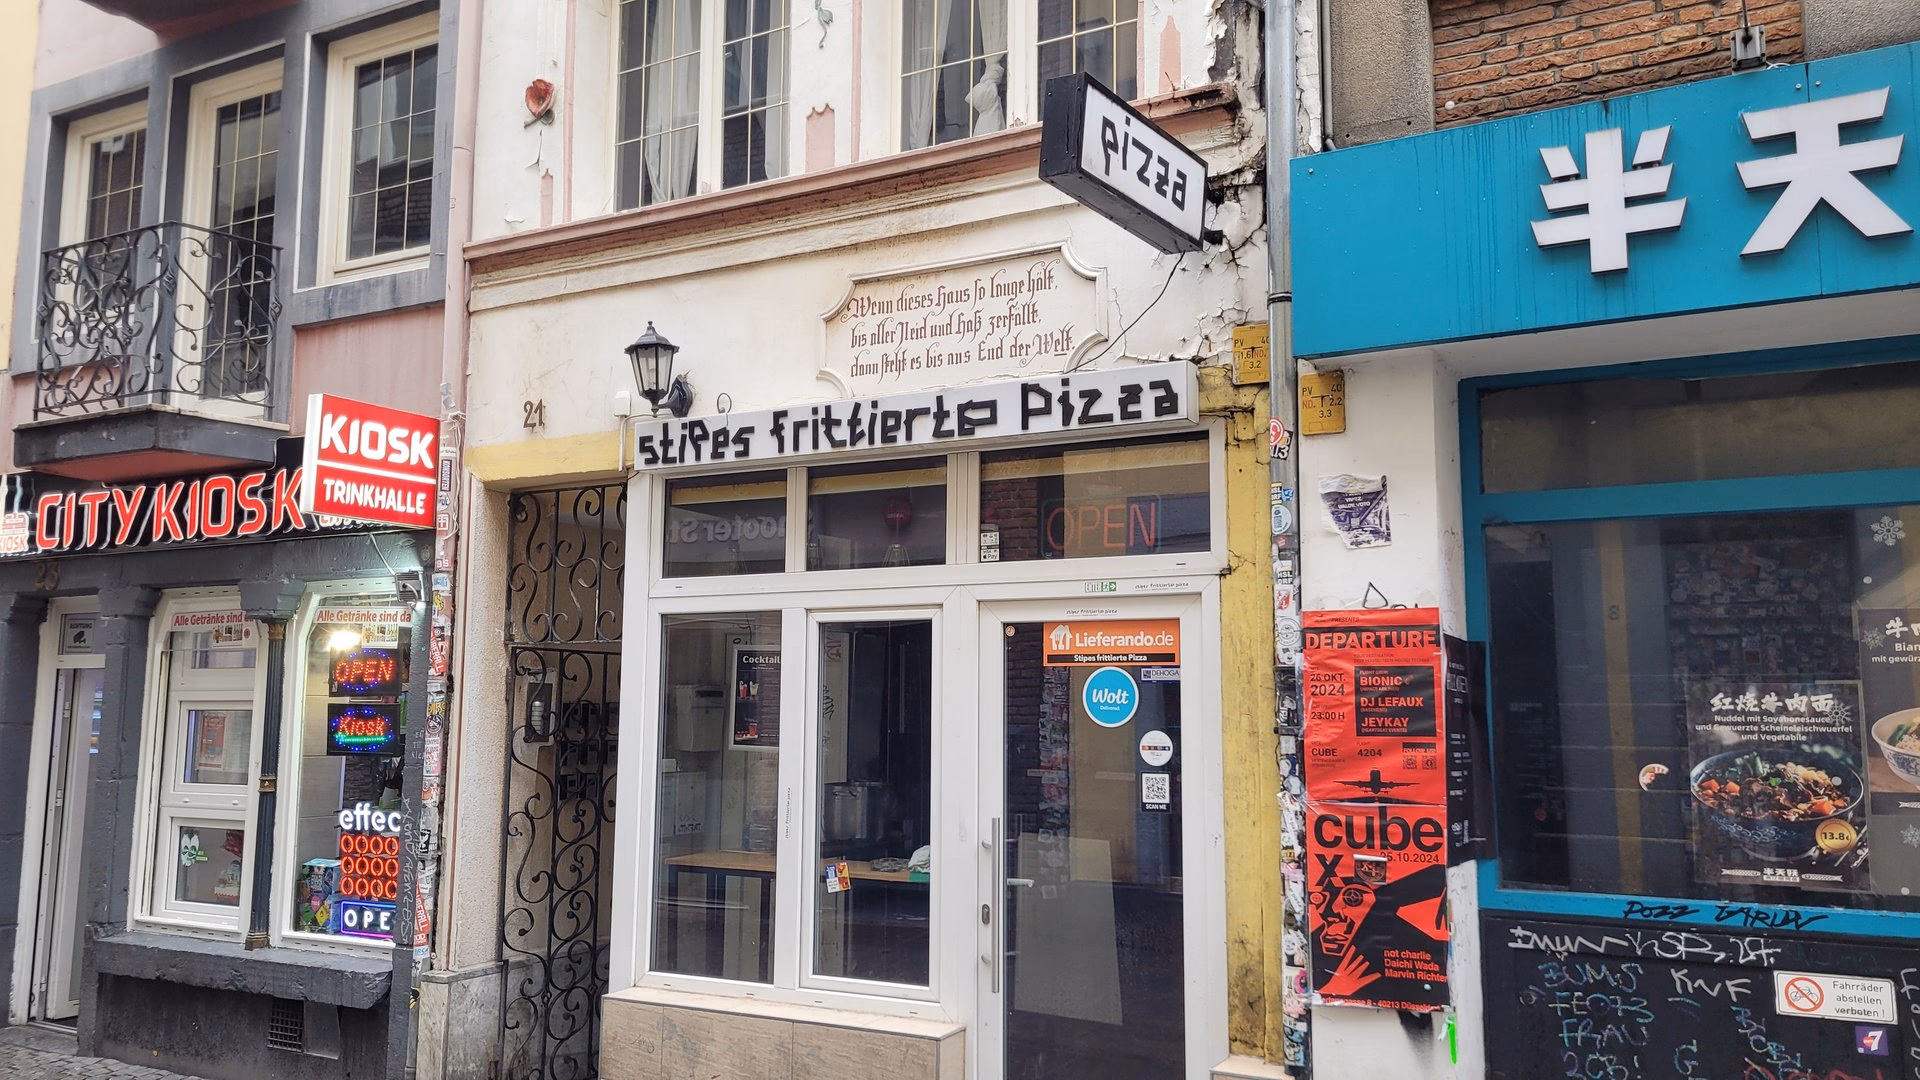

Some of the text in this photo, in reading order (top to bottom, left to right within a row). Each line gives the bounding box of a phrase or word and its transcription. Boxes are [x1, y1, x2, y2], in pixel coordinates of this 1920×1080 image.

[1100, 115, 1188, 212] pizza
[841, 296, 893, 323] Wenn
[896, 284, 933, 312] dieses
[934, 285, 970, 316] Haus
[990, 268, 1025, 305] lange
[851, 321, 867, 348] bis
[870, 317, 895, 346] aller
[895, 311, 935, 351] Neid
[930, 308, 960, 337] und
[1234, 339, 1245, 347] PV
[850, 349, 879, 377] dann
[910, 355, 922, 370] es
[926, 342, 943, 368] bis
[977, 336, 1006, 361] End
[1009, 330, 1032, 358] der
[1240, 351, 1252, 359] 1.6
[1249, 361, 1262, 369] 3.2
[1302, 383, 1343, 396] PV 40
[1302, 397, 1343, 409] ND. 2.2
[523, 398, 546, 428] 21
[1318, 410, 1332, 418] 3.3
[320, 411, 435, 469] KIOSK
[322, 478, 427, 515] TRINKHALLE
[36, 484, 147, 550] CITY
[1047, 502, 1157, 551] OPEN
[0, 535, 27, 552] IOSK
[174, 615, 189, 627] Alle
[190, 612, 225, 625] Getränke
[226, 611, 243, 623] sind
[317, 611, 335, 622] Alle
[336, 610, 377, 622] Getränke
[379, 610, 398, 622] sind
[1075, 631, 1174, 648] Lieferando.de
[1305, 630, 1437, 649] DEPARTURE
[1073, 653, 1148, 663] Stipes frittierte Pizza
[1871, 655, 1887, 663] mit
[335, 659, 396, 682] OPEN
[1310, 673, 1346, 682] 26 OKT.
[1360, 676, 1403, 686] BIONIC
[1310, 684, 1345, 696] 2024
[1091, 688, 1129, 705] Wolt
[1360, 697, 1424, 707] DJ LEFAUX
[1709, 691, 1835, 713] 红烧牛肉面
[1311, 711, 1345, 720] 23:00 H
[1714, 714, 1746, 723] Nuddel
[1746, 715, 1761, 723] mit
[338, 716, 386, 736] Kiosk
[1361, 717, 1409, 727] JEYKAY
[1741, 733, 1759, 741] und
[1311, 748, 1382, 757] CUBE 4204
[1313, 806, 1444, 853] cube
[1383, 950, 1431, 960] not charlie
[1384, 959, 1440, 971] Daichi Wada
[1384, 969, 1448, 983] Marvin Richter
[1832, 980, 1885, 993] Fahrräder
[1377, 999, 1400, 1009] 40213
[1835, 994, 1882, 1005] abstellen
[1834, 1006, 1880, 1017] verboten
